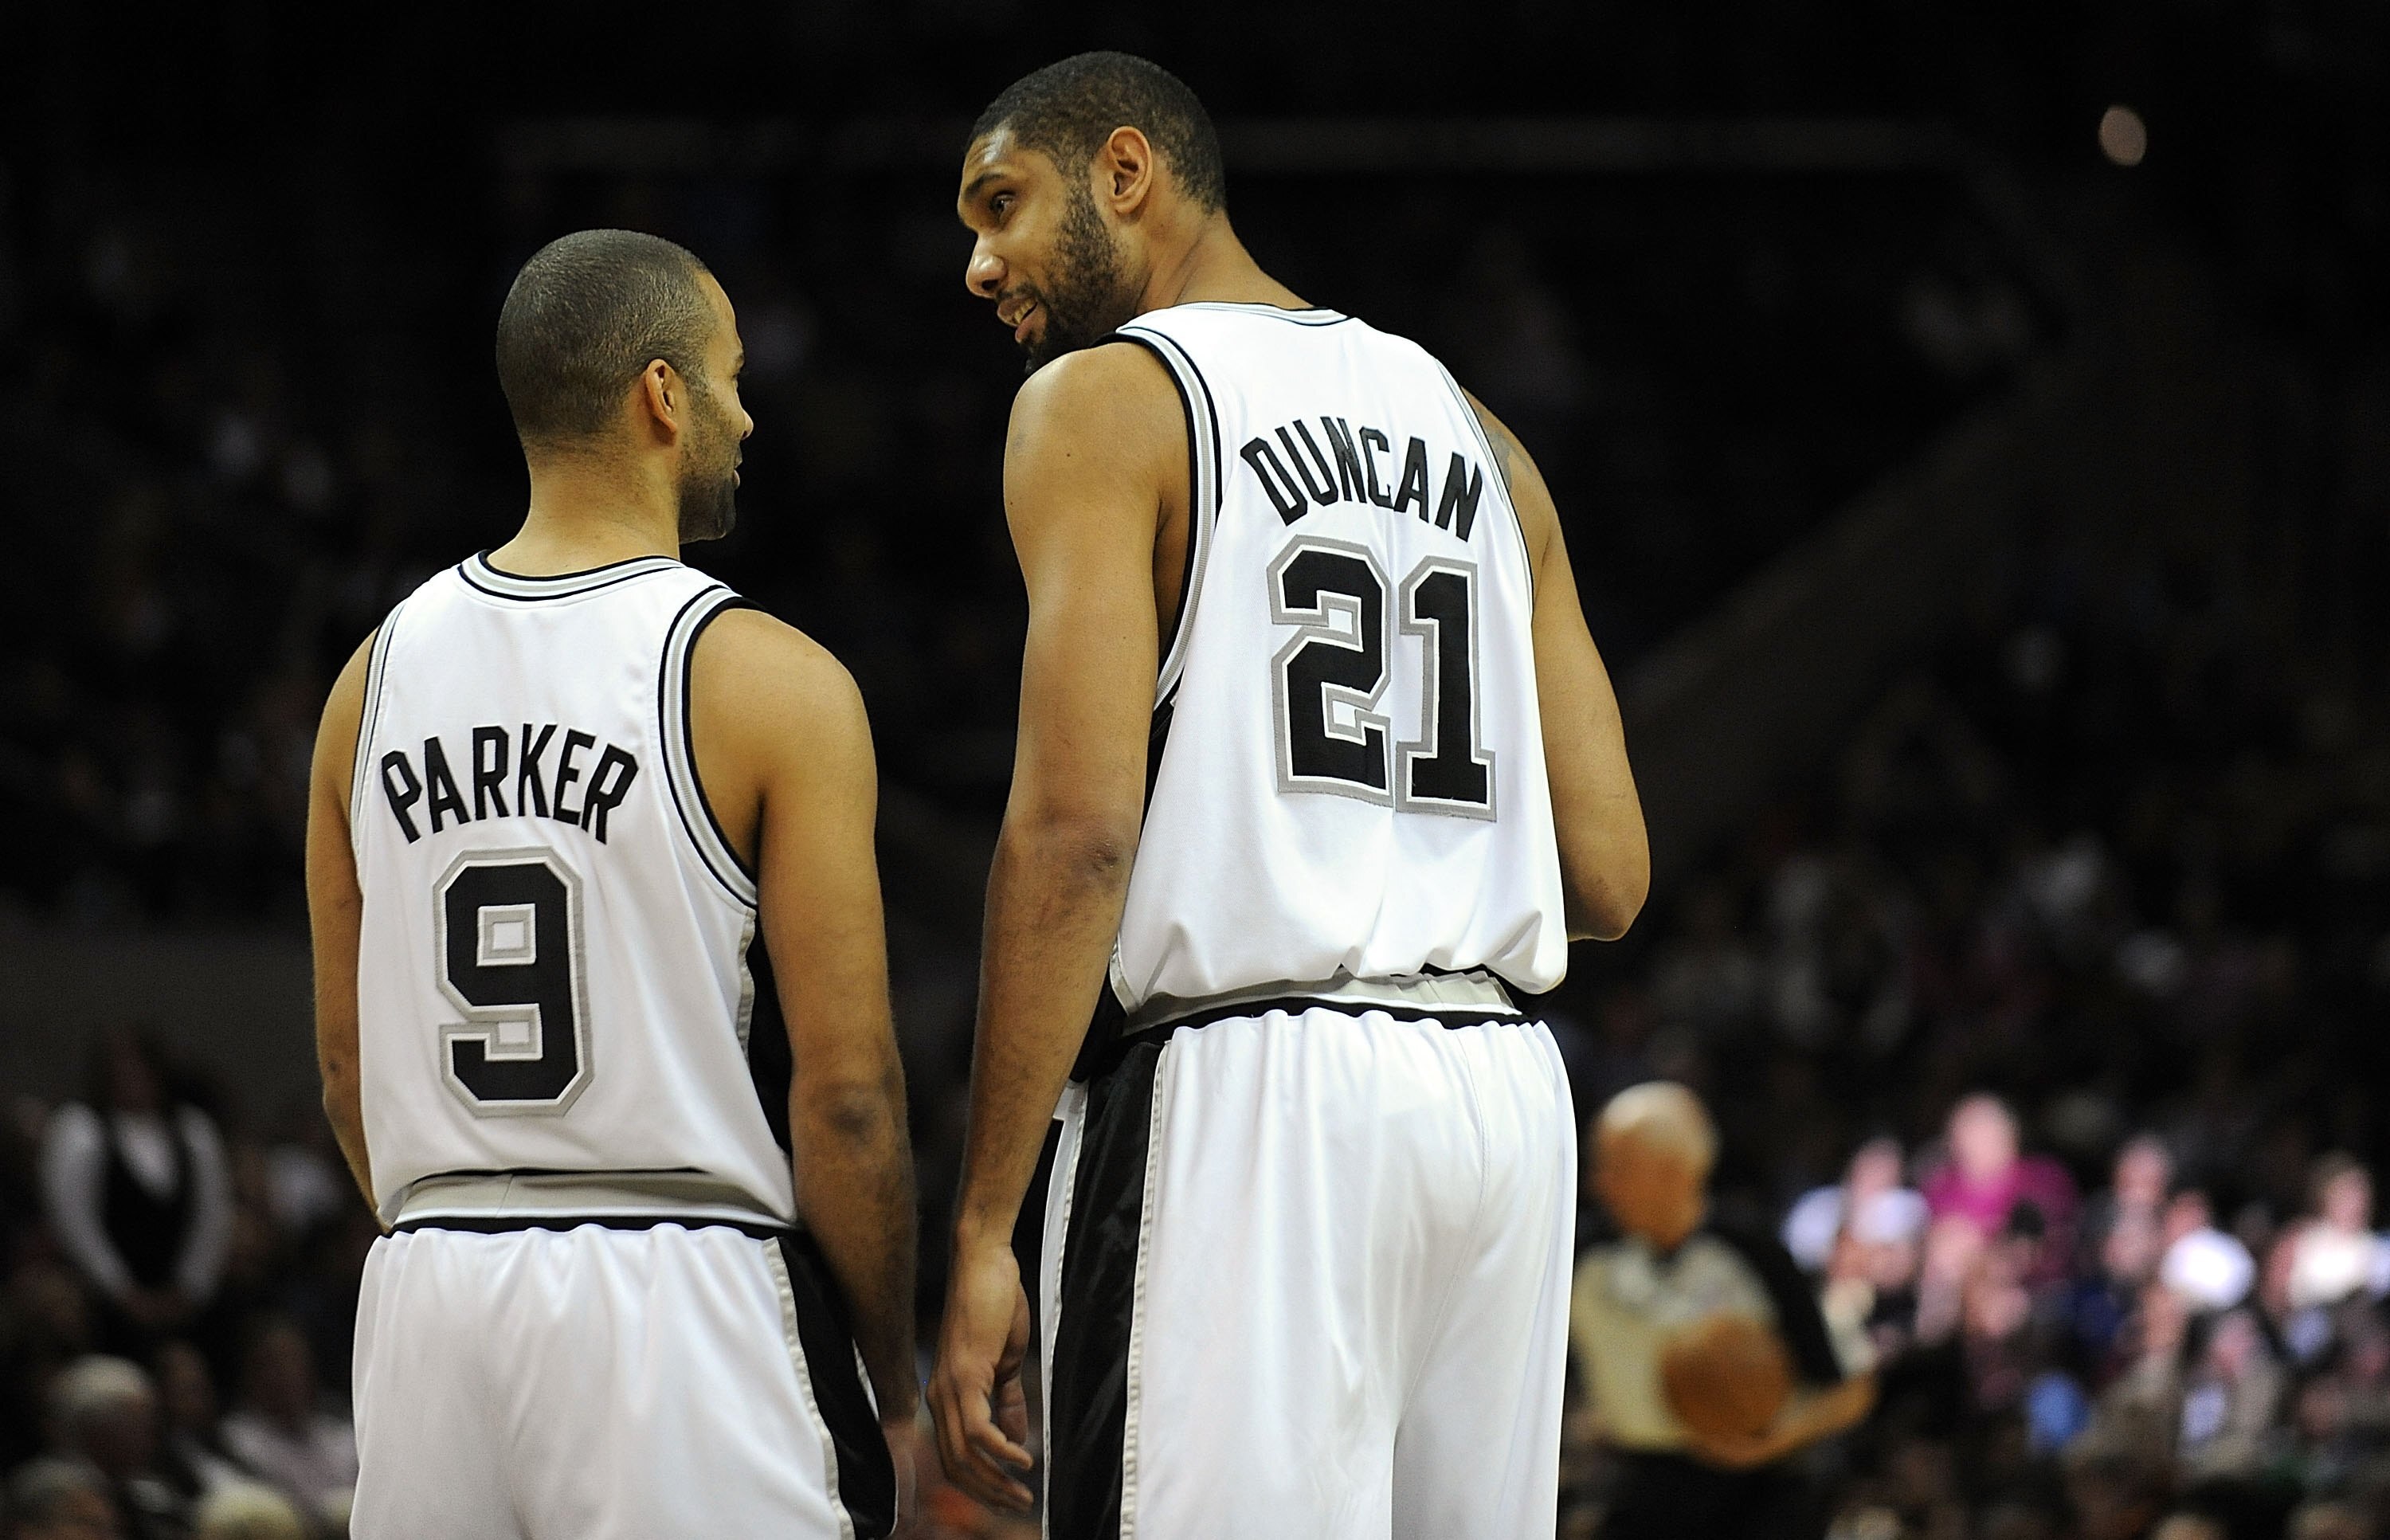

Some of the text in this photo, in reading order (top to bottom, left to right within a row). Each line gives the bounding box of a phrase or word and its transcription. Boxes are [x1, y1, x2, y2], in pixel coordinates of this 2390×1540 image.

[1240, 417, 1483, 543] DUNCAN
[1267, 535, 1497, 821] 21
[381, 723, 639, 844] PARKER
[433, 848, 595, 1118] 9
